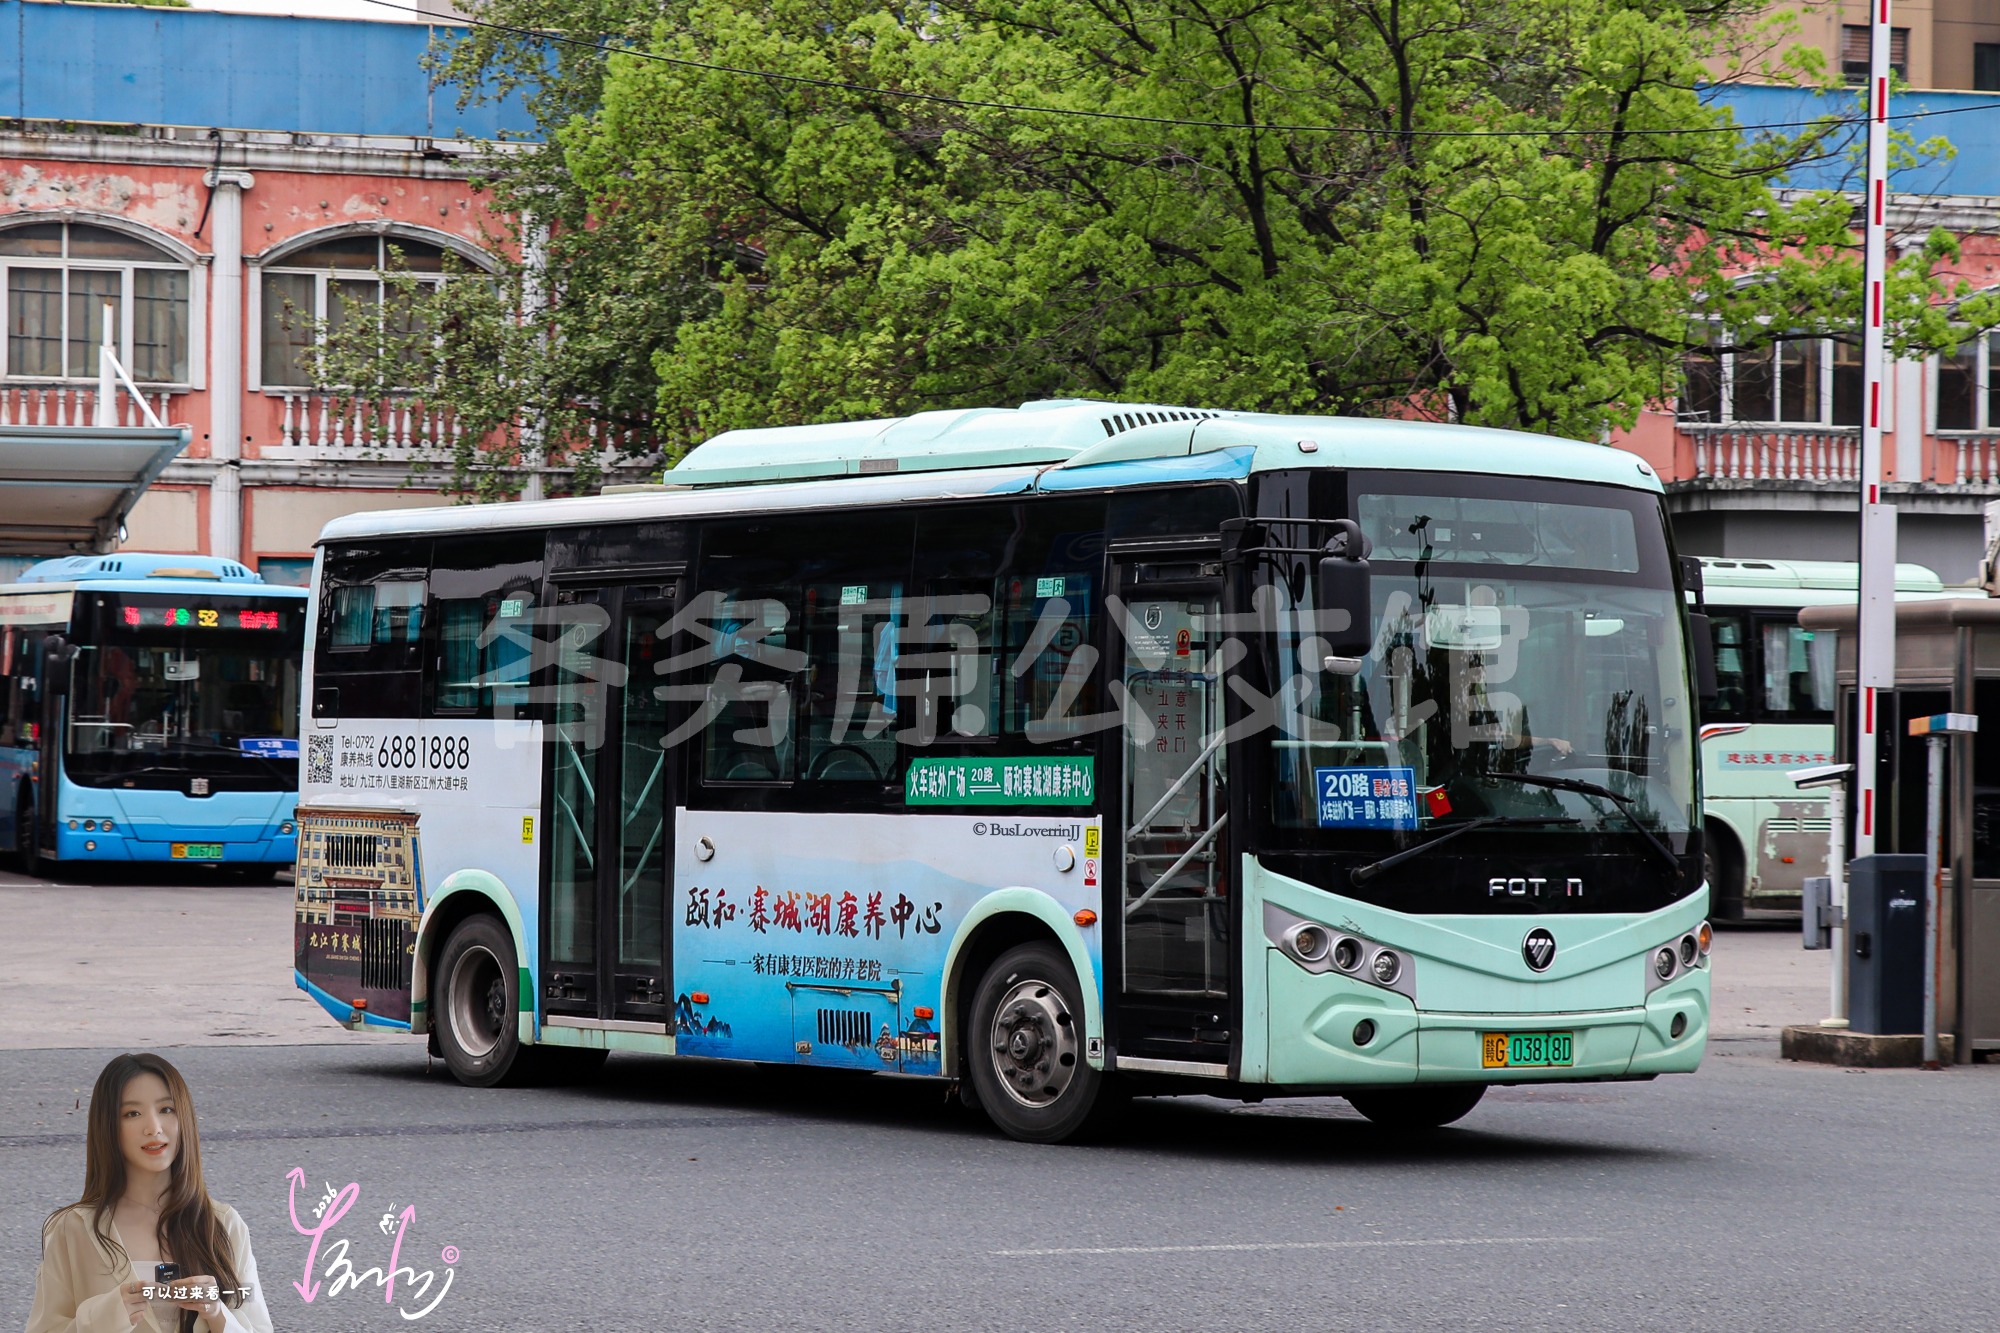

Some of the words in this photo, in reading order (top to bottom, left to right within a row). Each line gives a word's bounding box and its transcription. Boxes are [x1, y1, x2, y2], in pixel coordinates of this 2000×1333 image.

[340, 751, 374, 768] 康养热线
[378, 735, 470, 770] 6881888
[910, 765, 966, 798] 火车站外广场
[971, 766, 994, 783] 20路
[1003, 764, 1092, 798] 颐和赛城湖康养中心
[1325, 773, 1370, 798] 20路
[1373, 778, 1409, 798] 票价2元
[1489, 877, 1584, 897] FOTN
[686, 884, 943, 941] 颐和·赛城湖康养中心
[740, 952, 882, 981] 一家有康复医院的养老院
